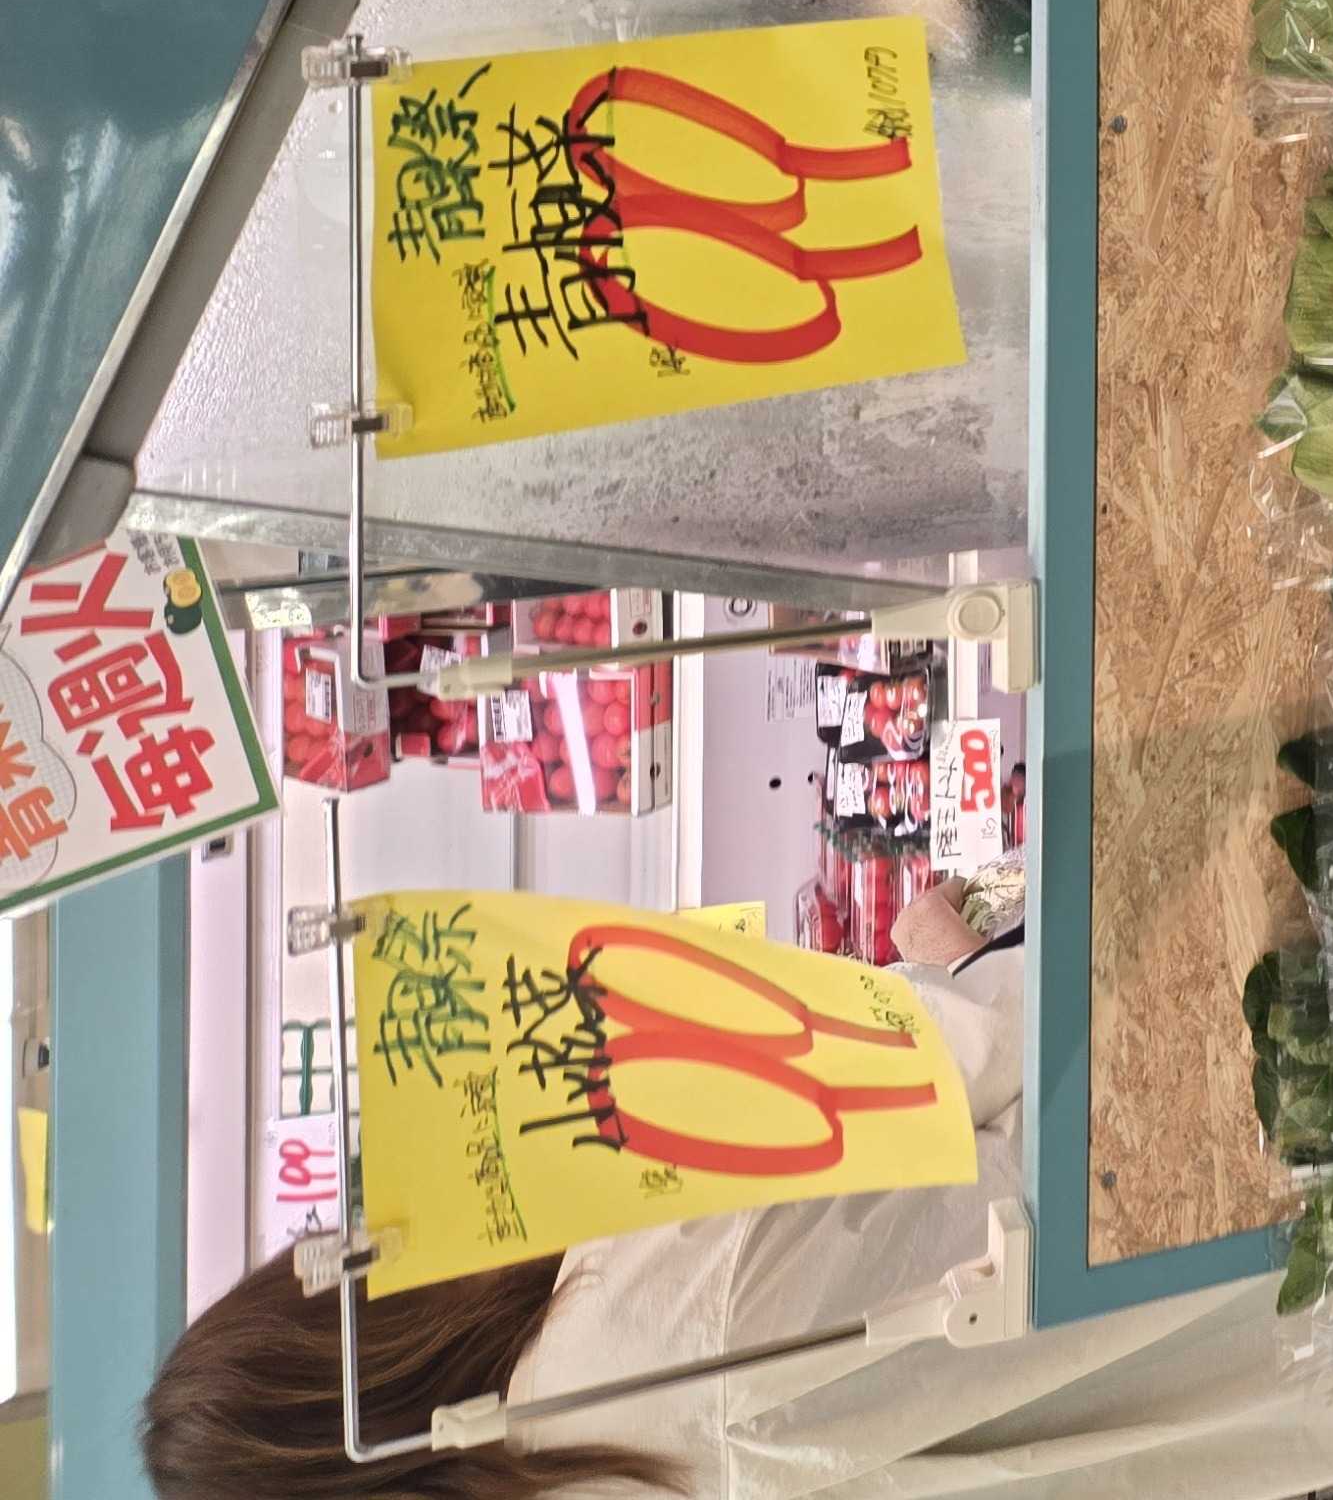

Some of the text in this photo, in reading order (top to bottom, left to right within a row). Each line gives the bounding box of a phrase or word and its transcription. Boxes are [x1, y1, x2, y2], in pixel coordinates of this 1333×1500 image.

[569, 65, 922, 364] 99
[20, 538, 215, 832] 毎週火
[502, 946, 627, 1151] 小松菜
[566, 923, 937, 1177] 99
